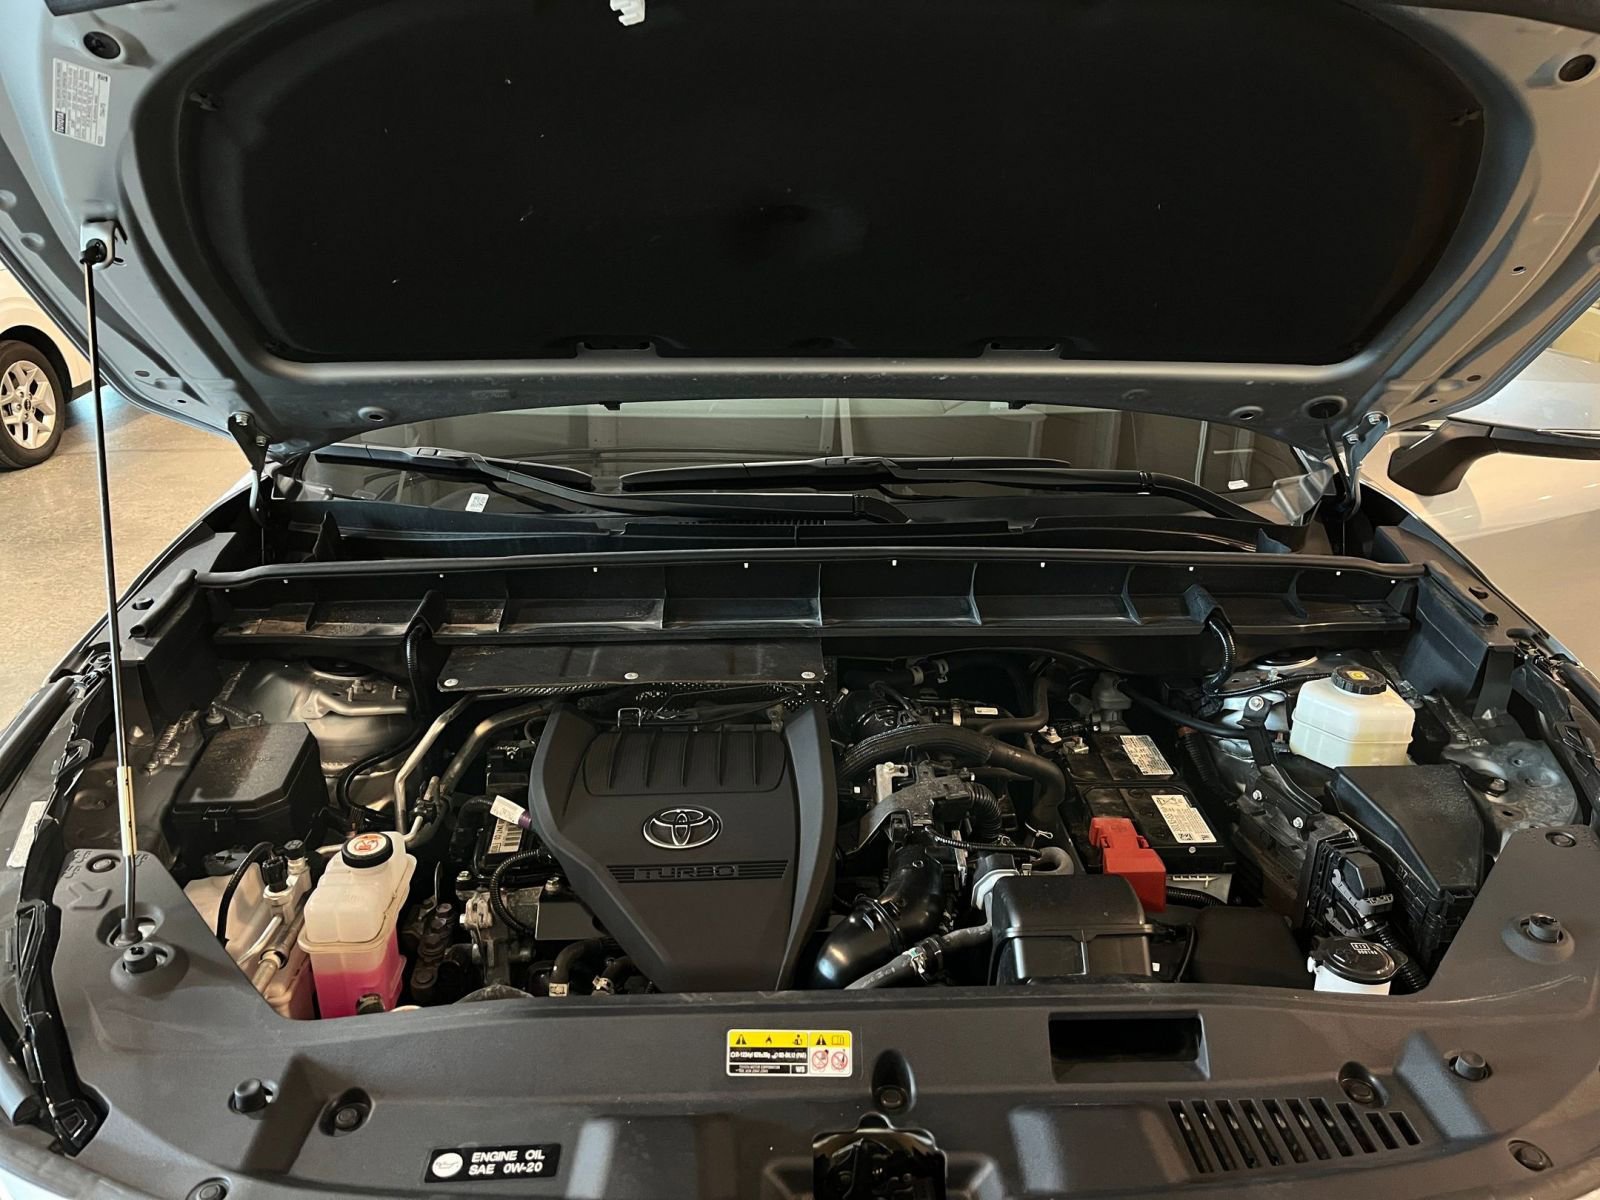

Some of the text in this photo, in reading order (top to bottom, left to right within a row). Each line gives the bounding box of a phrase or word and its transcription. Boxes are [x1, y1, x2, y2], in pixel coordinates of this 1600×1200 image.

[639, 866, 736, 880] TURBO
[471, 1149, 546, 1162] ENGINE OIL
[468, 1162, 543, 1175] SAE 0W-20
